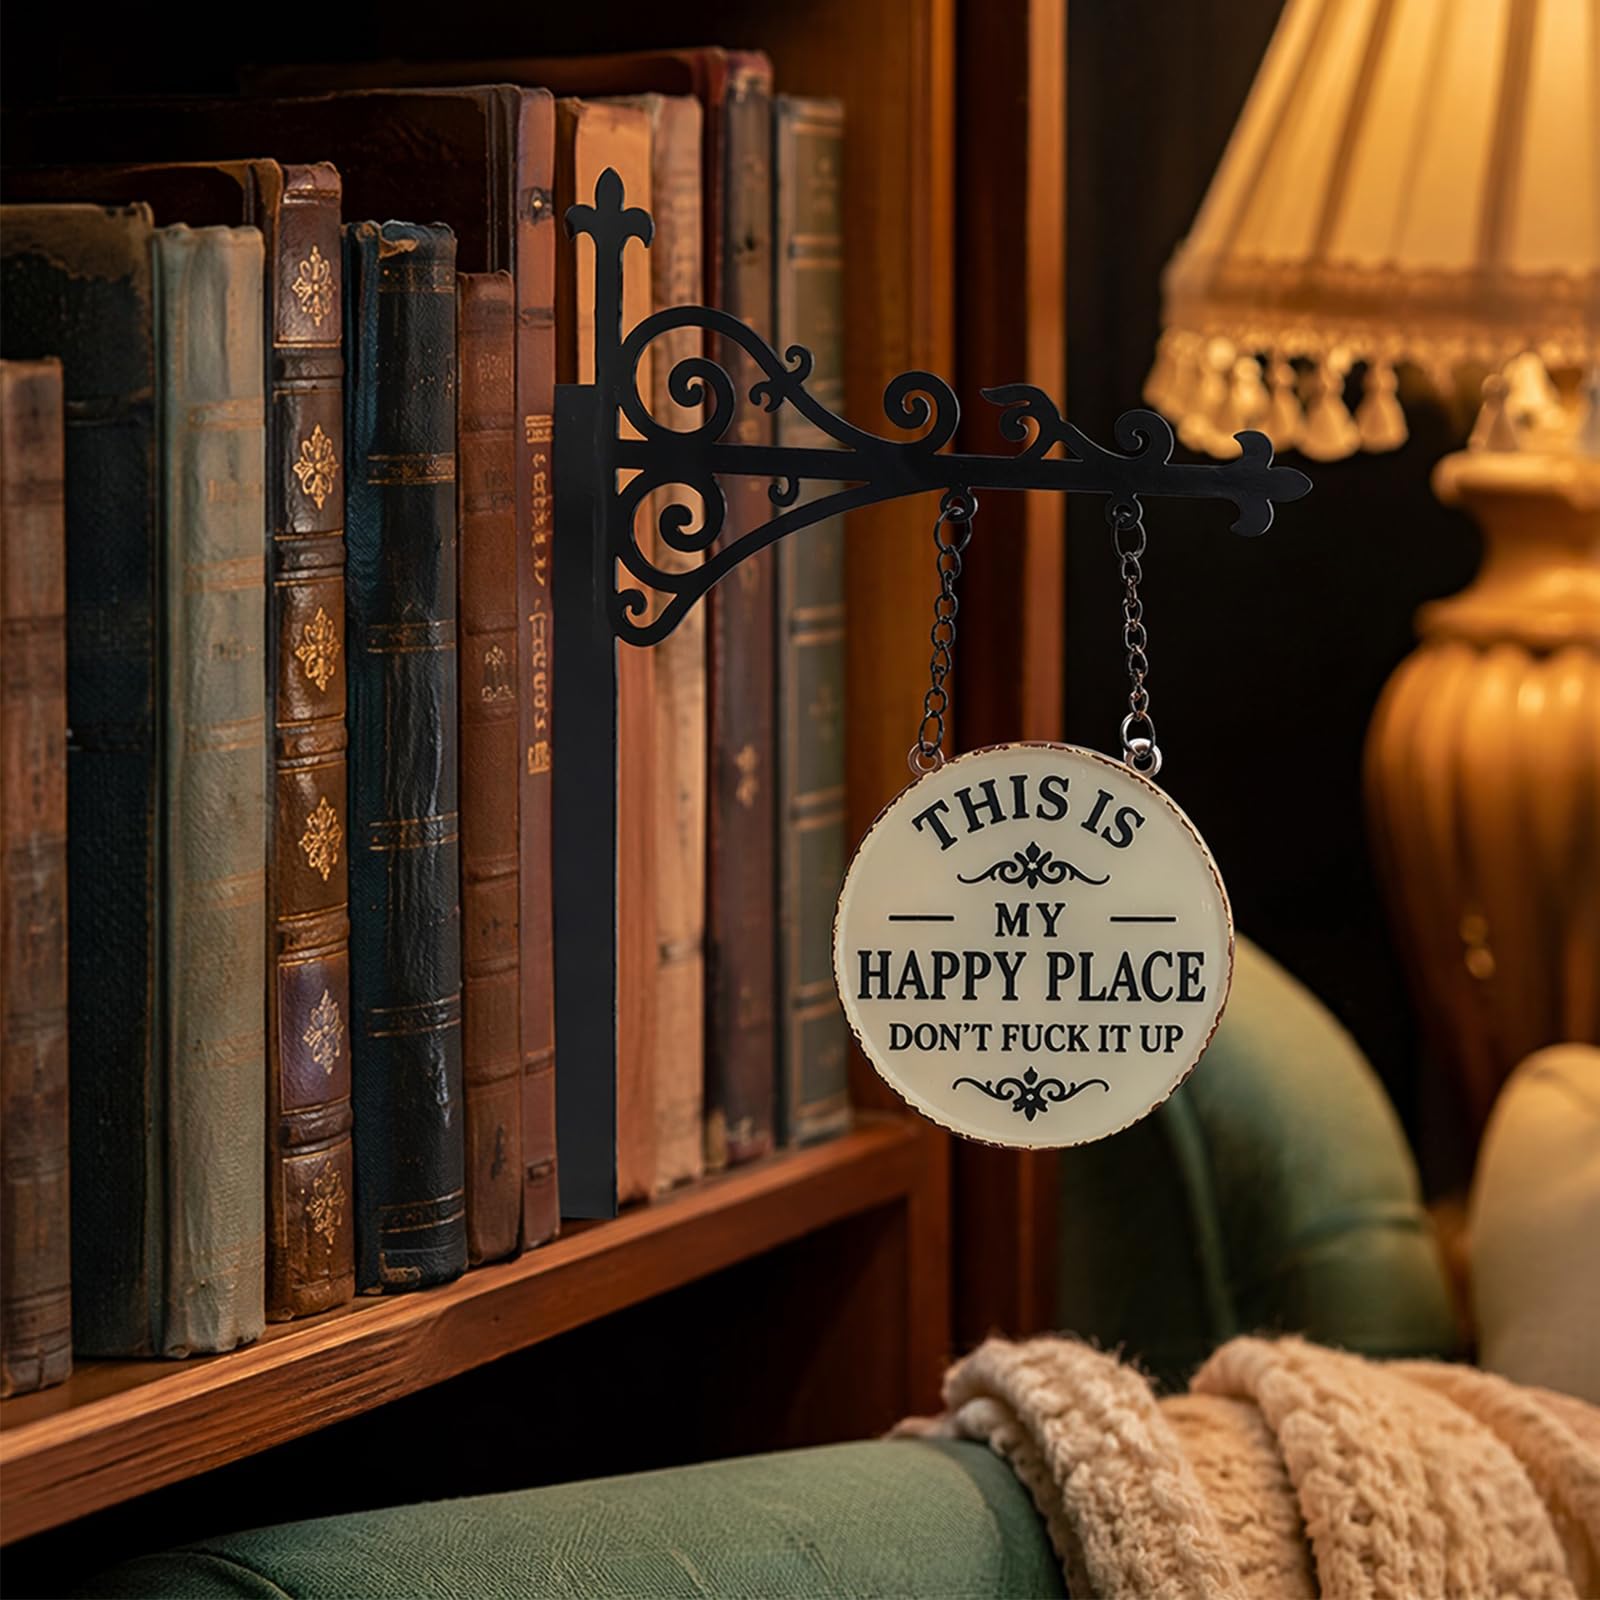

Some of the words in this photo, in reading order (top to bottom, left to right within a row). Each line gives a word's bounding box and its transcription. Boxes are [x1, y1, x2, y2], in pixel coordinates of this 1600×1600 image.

[912, 775, 1069, 851] THIS
[1081, 789, 1146, 848] IS
[995, 903, 1066, 937] MY
[857, 950, 1027, 1001] HAPPY
[1046, 951, 1206, 1002] PLACE
[889, 1023, 993, 1051] DON’T
[1001, 1024, 1090, 1052] FUCK
[1098, 1025, 1131, 1052] IT
[1140, 1025, 1184, 1053] UP
